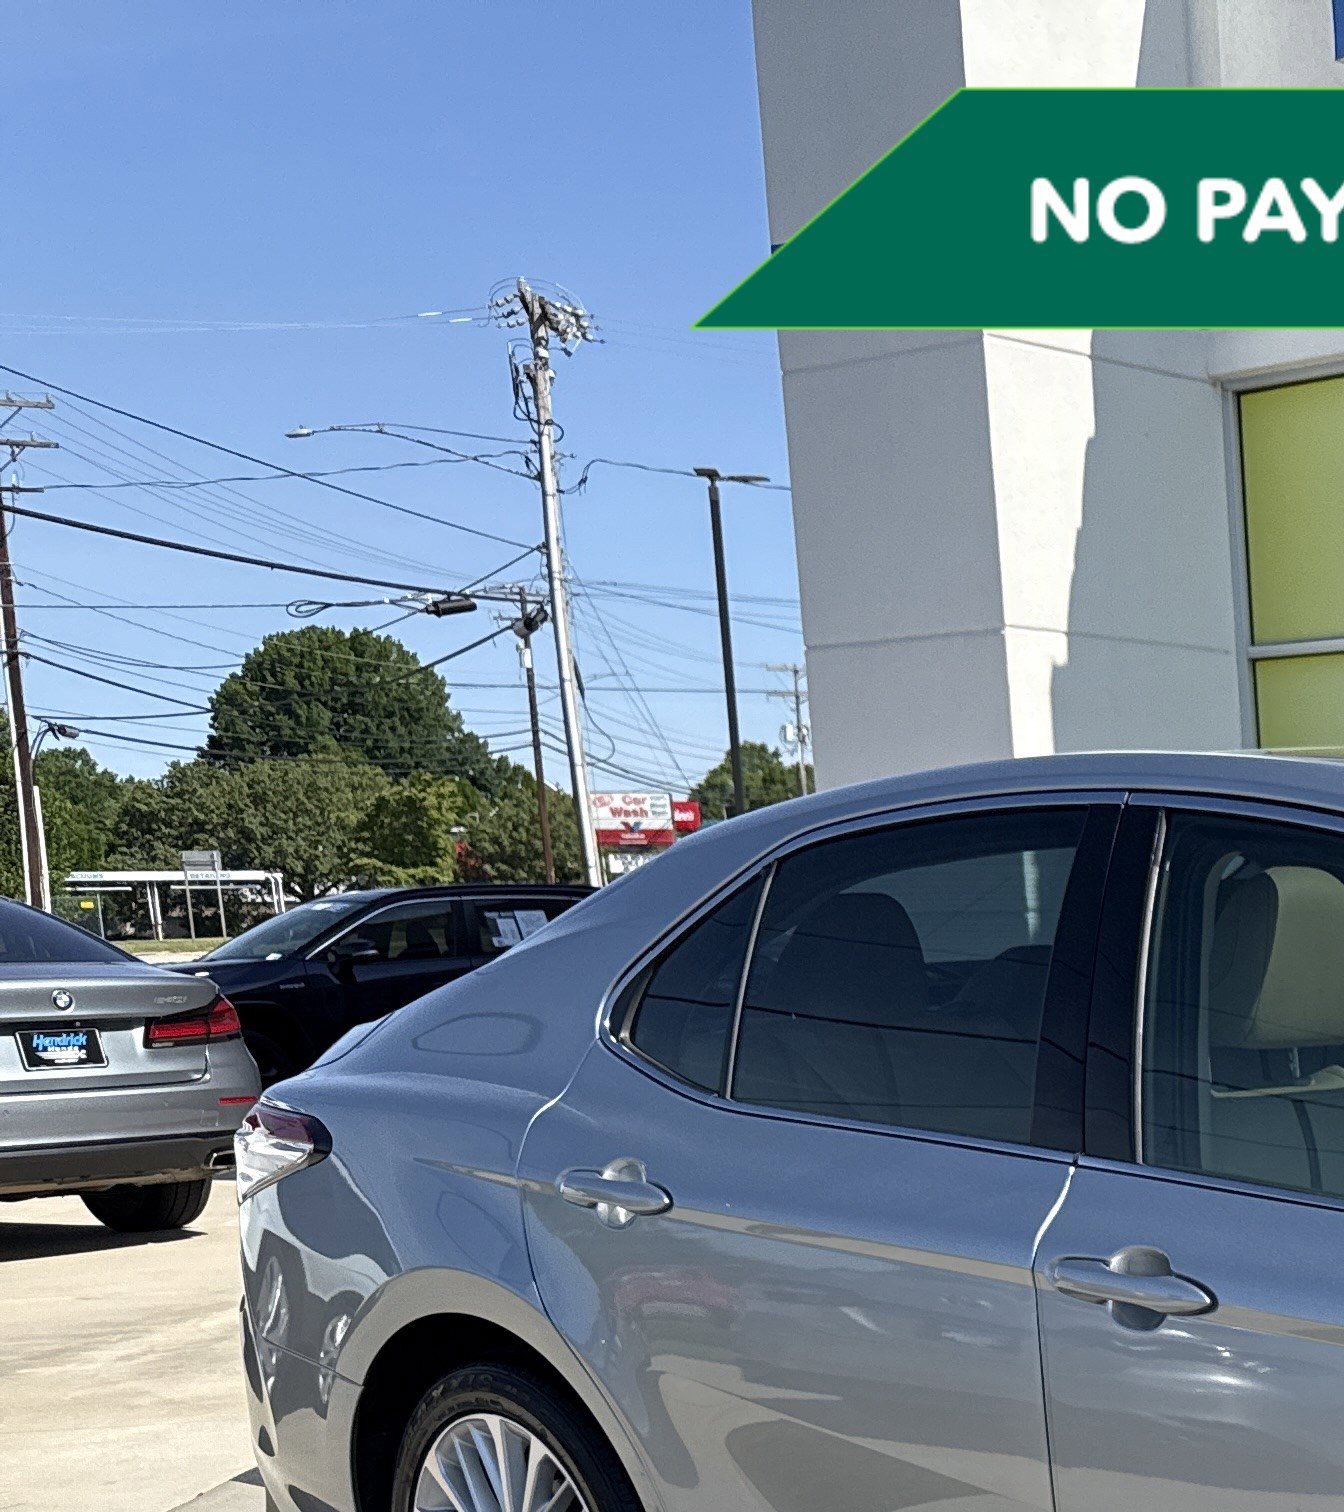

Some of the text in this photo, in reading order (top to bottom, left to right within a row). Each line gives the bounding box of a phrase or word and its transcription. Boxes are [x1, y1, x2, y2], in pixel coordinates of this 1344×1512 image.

[621, 794, 647, 805] Car
[609, 806, 649, 818] Wash
[32, 1032, 88, 1051] Hendrick
